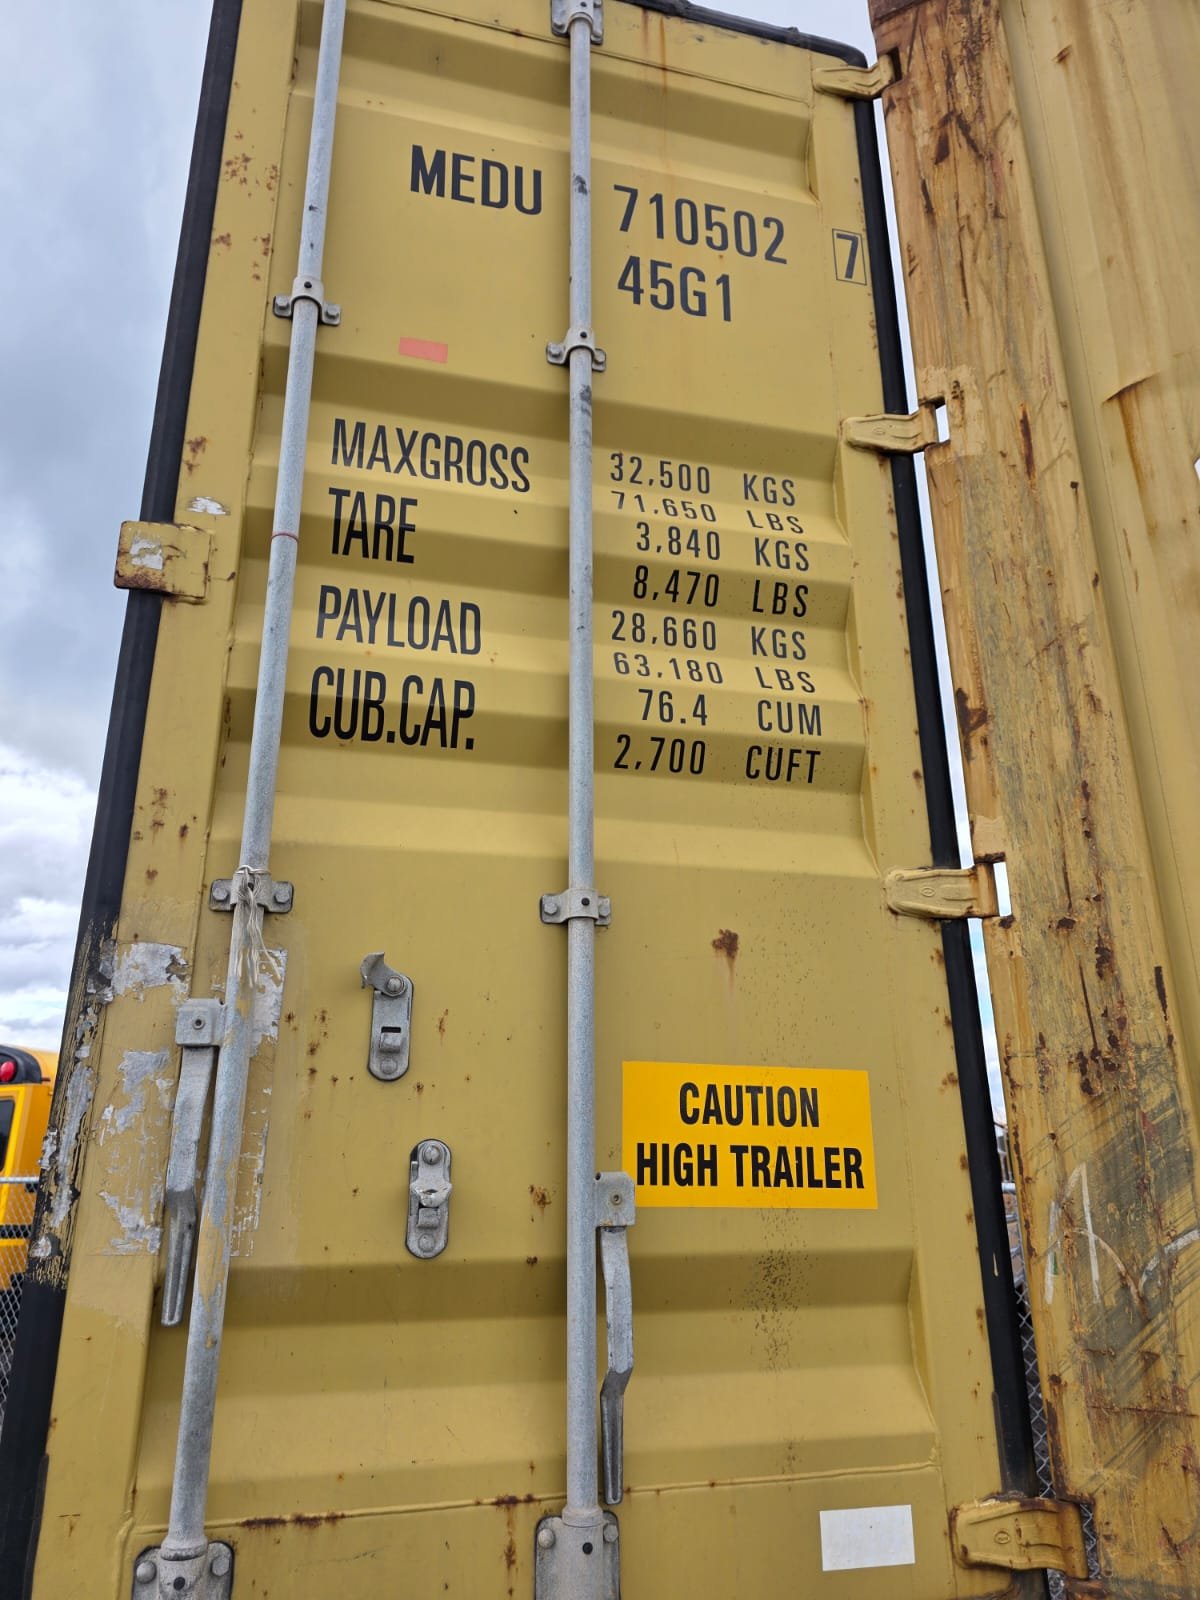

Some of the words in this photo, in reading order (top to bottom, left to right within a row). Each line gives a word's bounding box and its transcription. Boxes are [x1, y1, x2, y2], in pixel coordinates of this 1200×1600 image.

[409, 144, 542, 215] MEDU
[613, 184, 788, 264] 710502
[835, 233, 859, 279] 7
[617, 255, 732, 322] 45G1
[330, 418, 531, 493] MAXGROSS
[742, 473, 796, 507] KGS
[328, 487, 418, 564] TARE
[754, 536, 810, 572] KGS
[747, 510, 804, 535] LBS
[316, 584, 482, 656] PAYLOAD
[751, 626, 807, 661] KGS
[751, 579, 809, 618] LBS
[309, 665, 476, 750] CUB.CAP.
[637, 688, 708, 726] 76.4
[757, 699, 822, 737] CUM
[755, 666, 816, 694] LBS
[613, 734, 706, 775] 2,700
[745, 744, 821, 784] CUFT
[679, 1081, 820, 1128] CAUTION
[635, 1142, 719, 1188] HIGH
[730, 1144, 865, 1190] TRAILER
